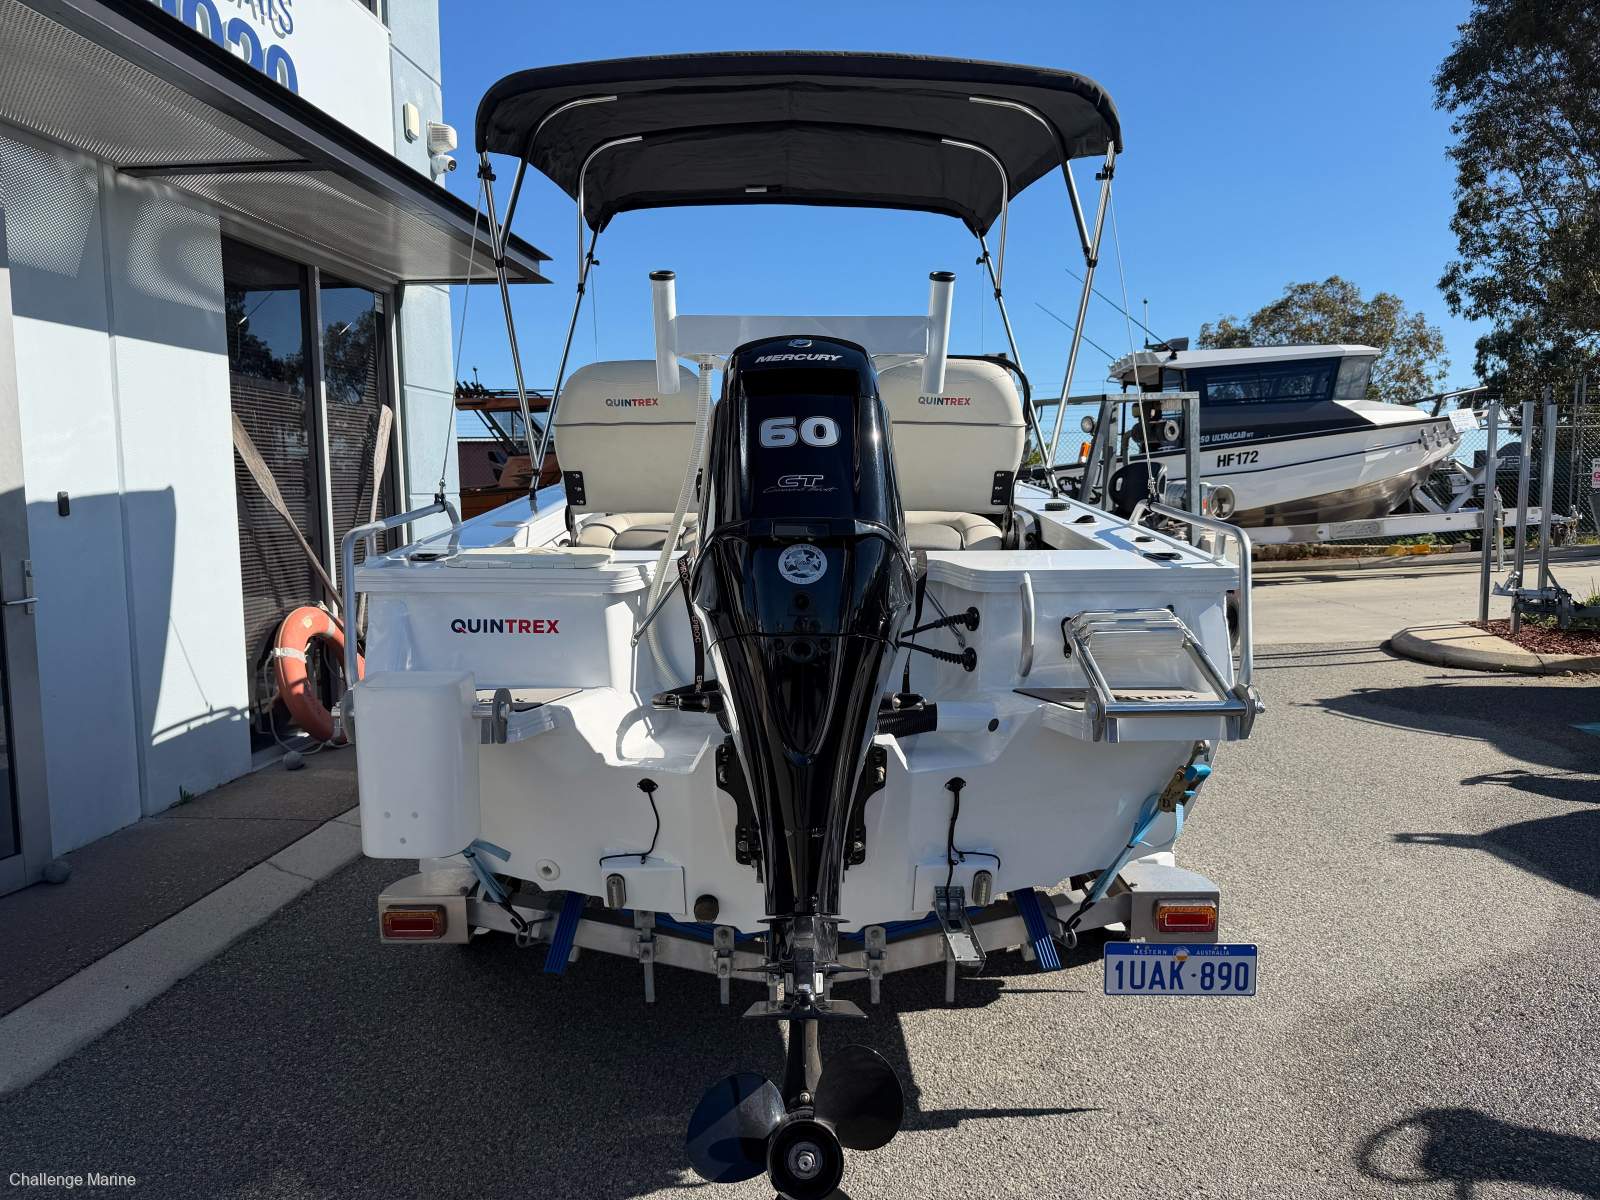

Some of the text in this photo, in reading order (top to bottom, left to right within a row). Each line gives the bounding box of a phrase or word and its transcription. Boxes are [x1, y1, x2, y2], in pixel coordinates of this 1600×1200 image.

[754, 353, 844, 364] MERCURY
[605, 398, 659, 407] QUINTREX
[918, 396, 972, 406] QUINTREX
[758, 415, 842, 449] 60
[1216, 450, 1259, 468] HF172
[450, 618, 560, 635] QUINTREX
[691, 615, 701, 644] EPIROC
